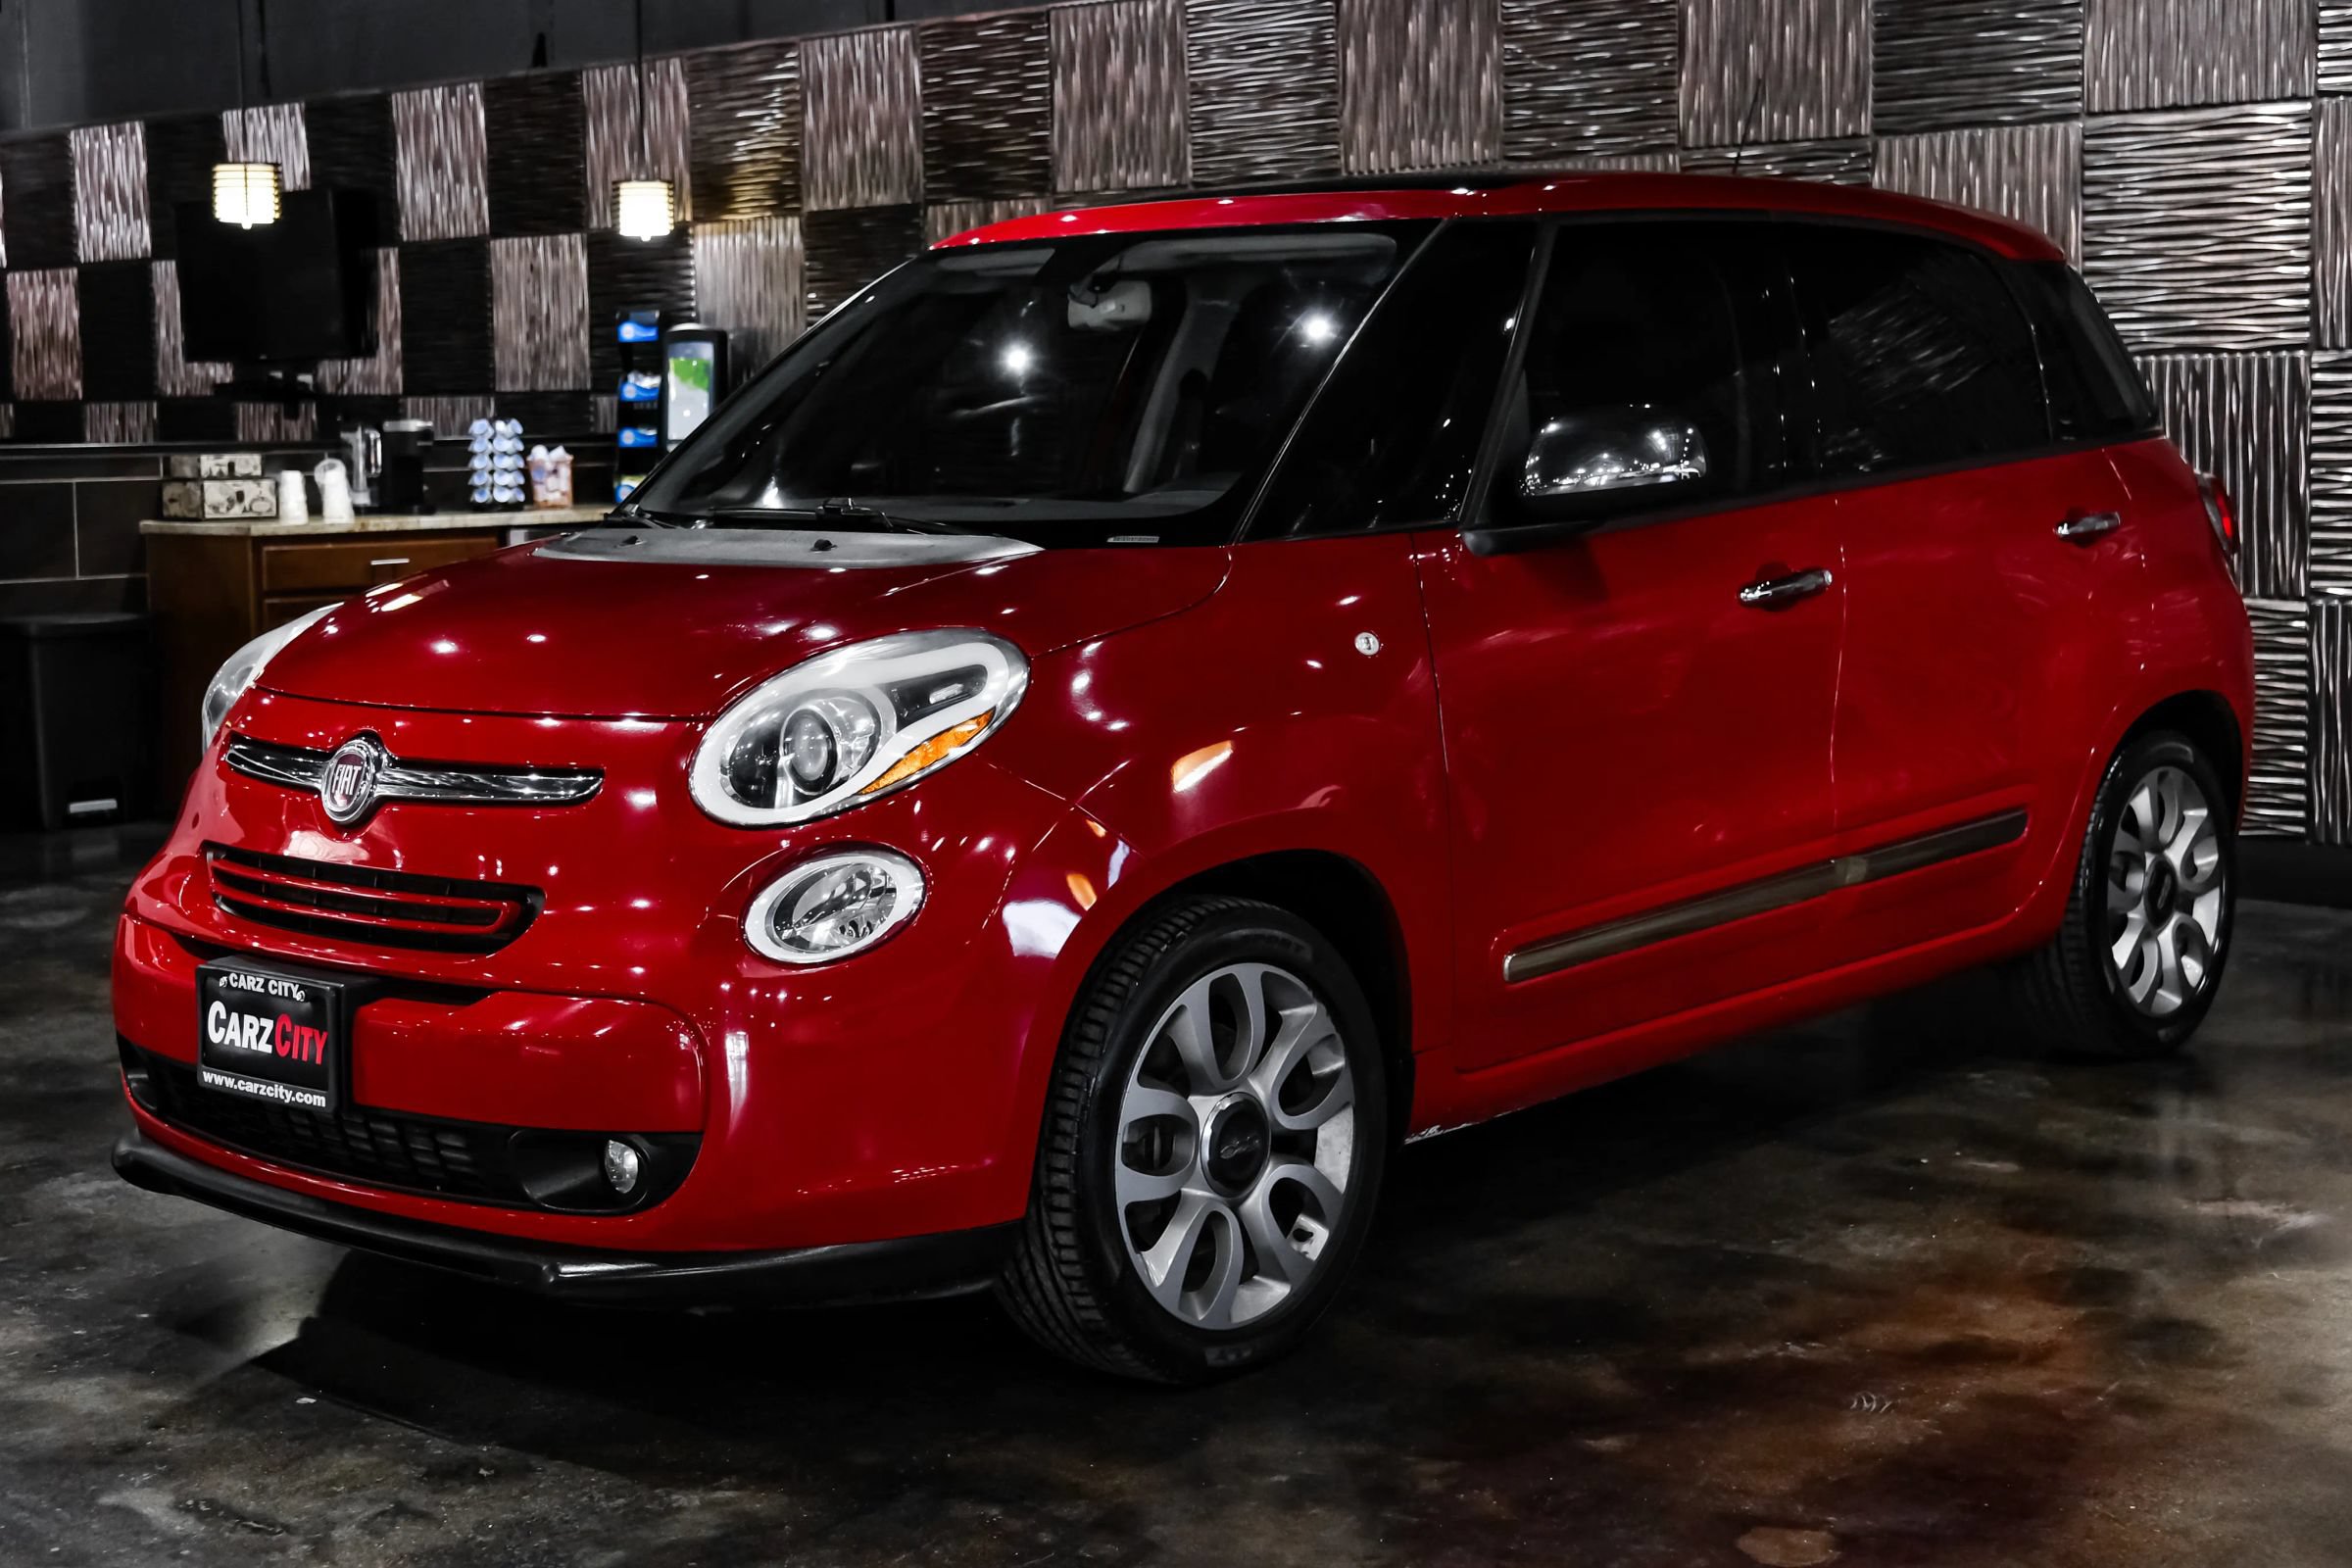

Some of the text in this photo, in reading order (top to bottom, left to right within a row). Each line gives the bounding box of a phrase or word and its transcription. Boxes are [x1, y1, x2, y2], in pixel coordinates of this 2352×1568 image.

[331, 764, 363, 796] FIAT
[228, 972, 300, 1000] CARZ CITY
[202, 1070, 326, 1107] www.carzcity.com
